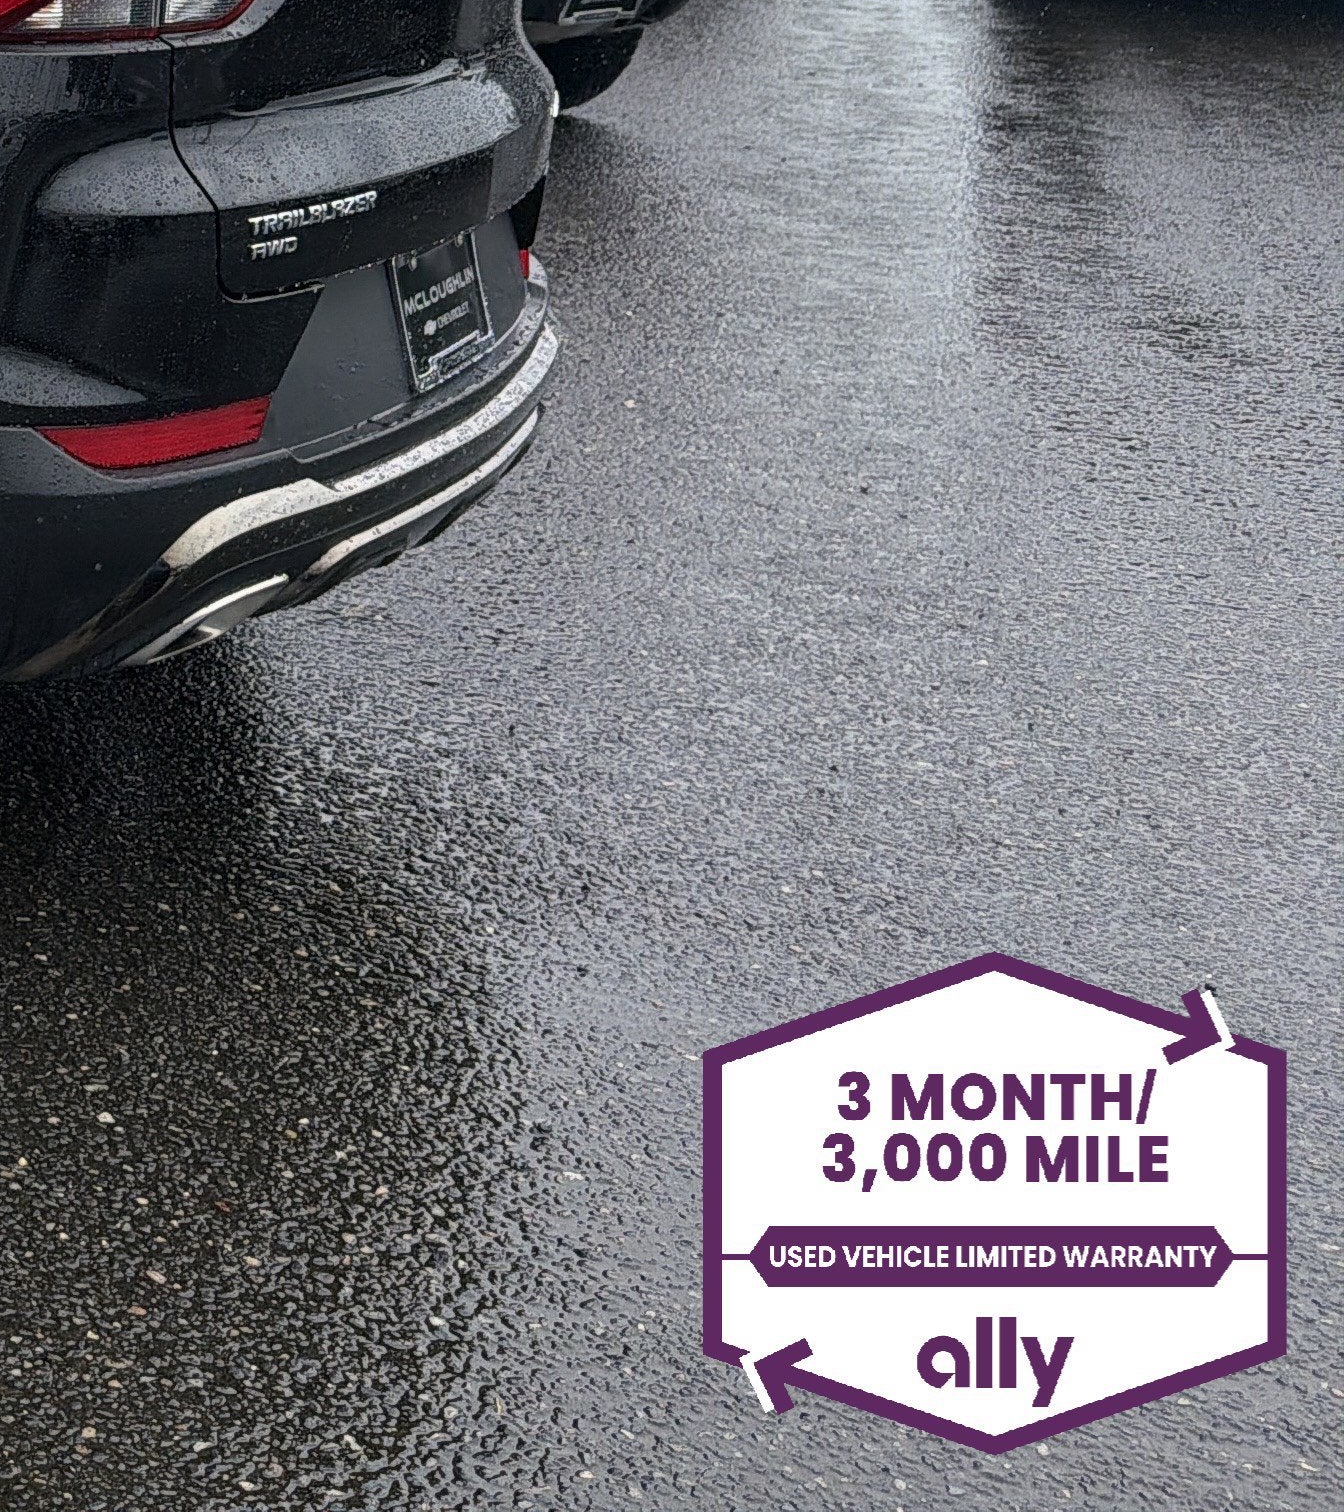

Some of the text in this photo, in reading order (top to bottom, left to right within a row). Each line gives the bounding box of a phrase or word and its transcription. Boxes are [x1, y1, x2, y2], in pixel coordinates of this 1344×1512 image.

[247, 190, 378, 236] TRAILBLAZER
[250, 236, 298, 260] AWD
[403, 264, 476, 317] MCLOUGHLIN
[436, 300, 470, 329] CHEVROLET
